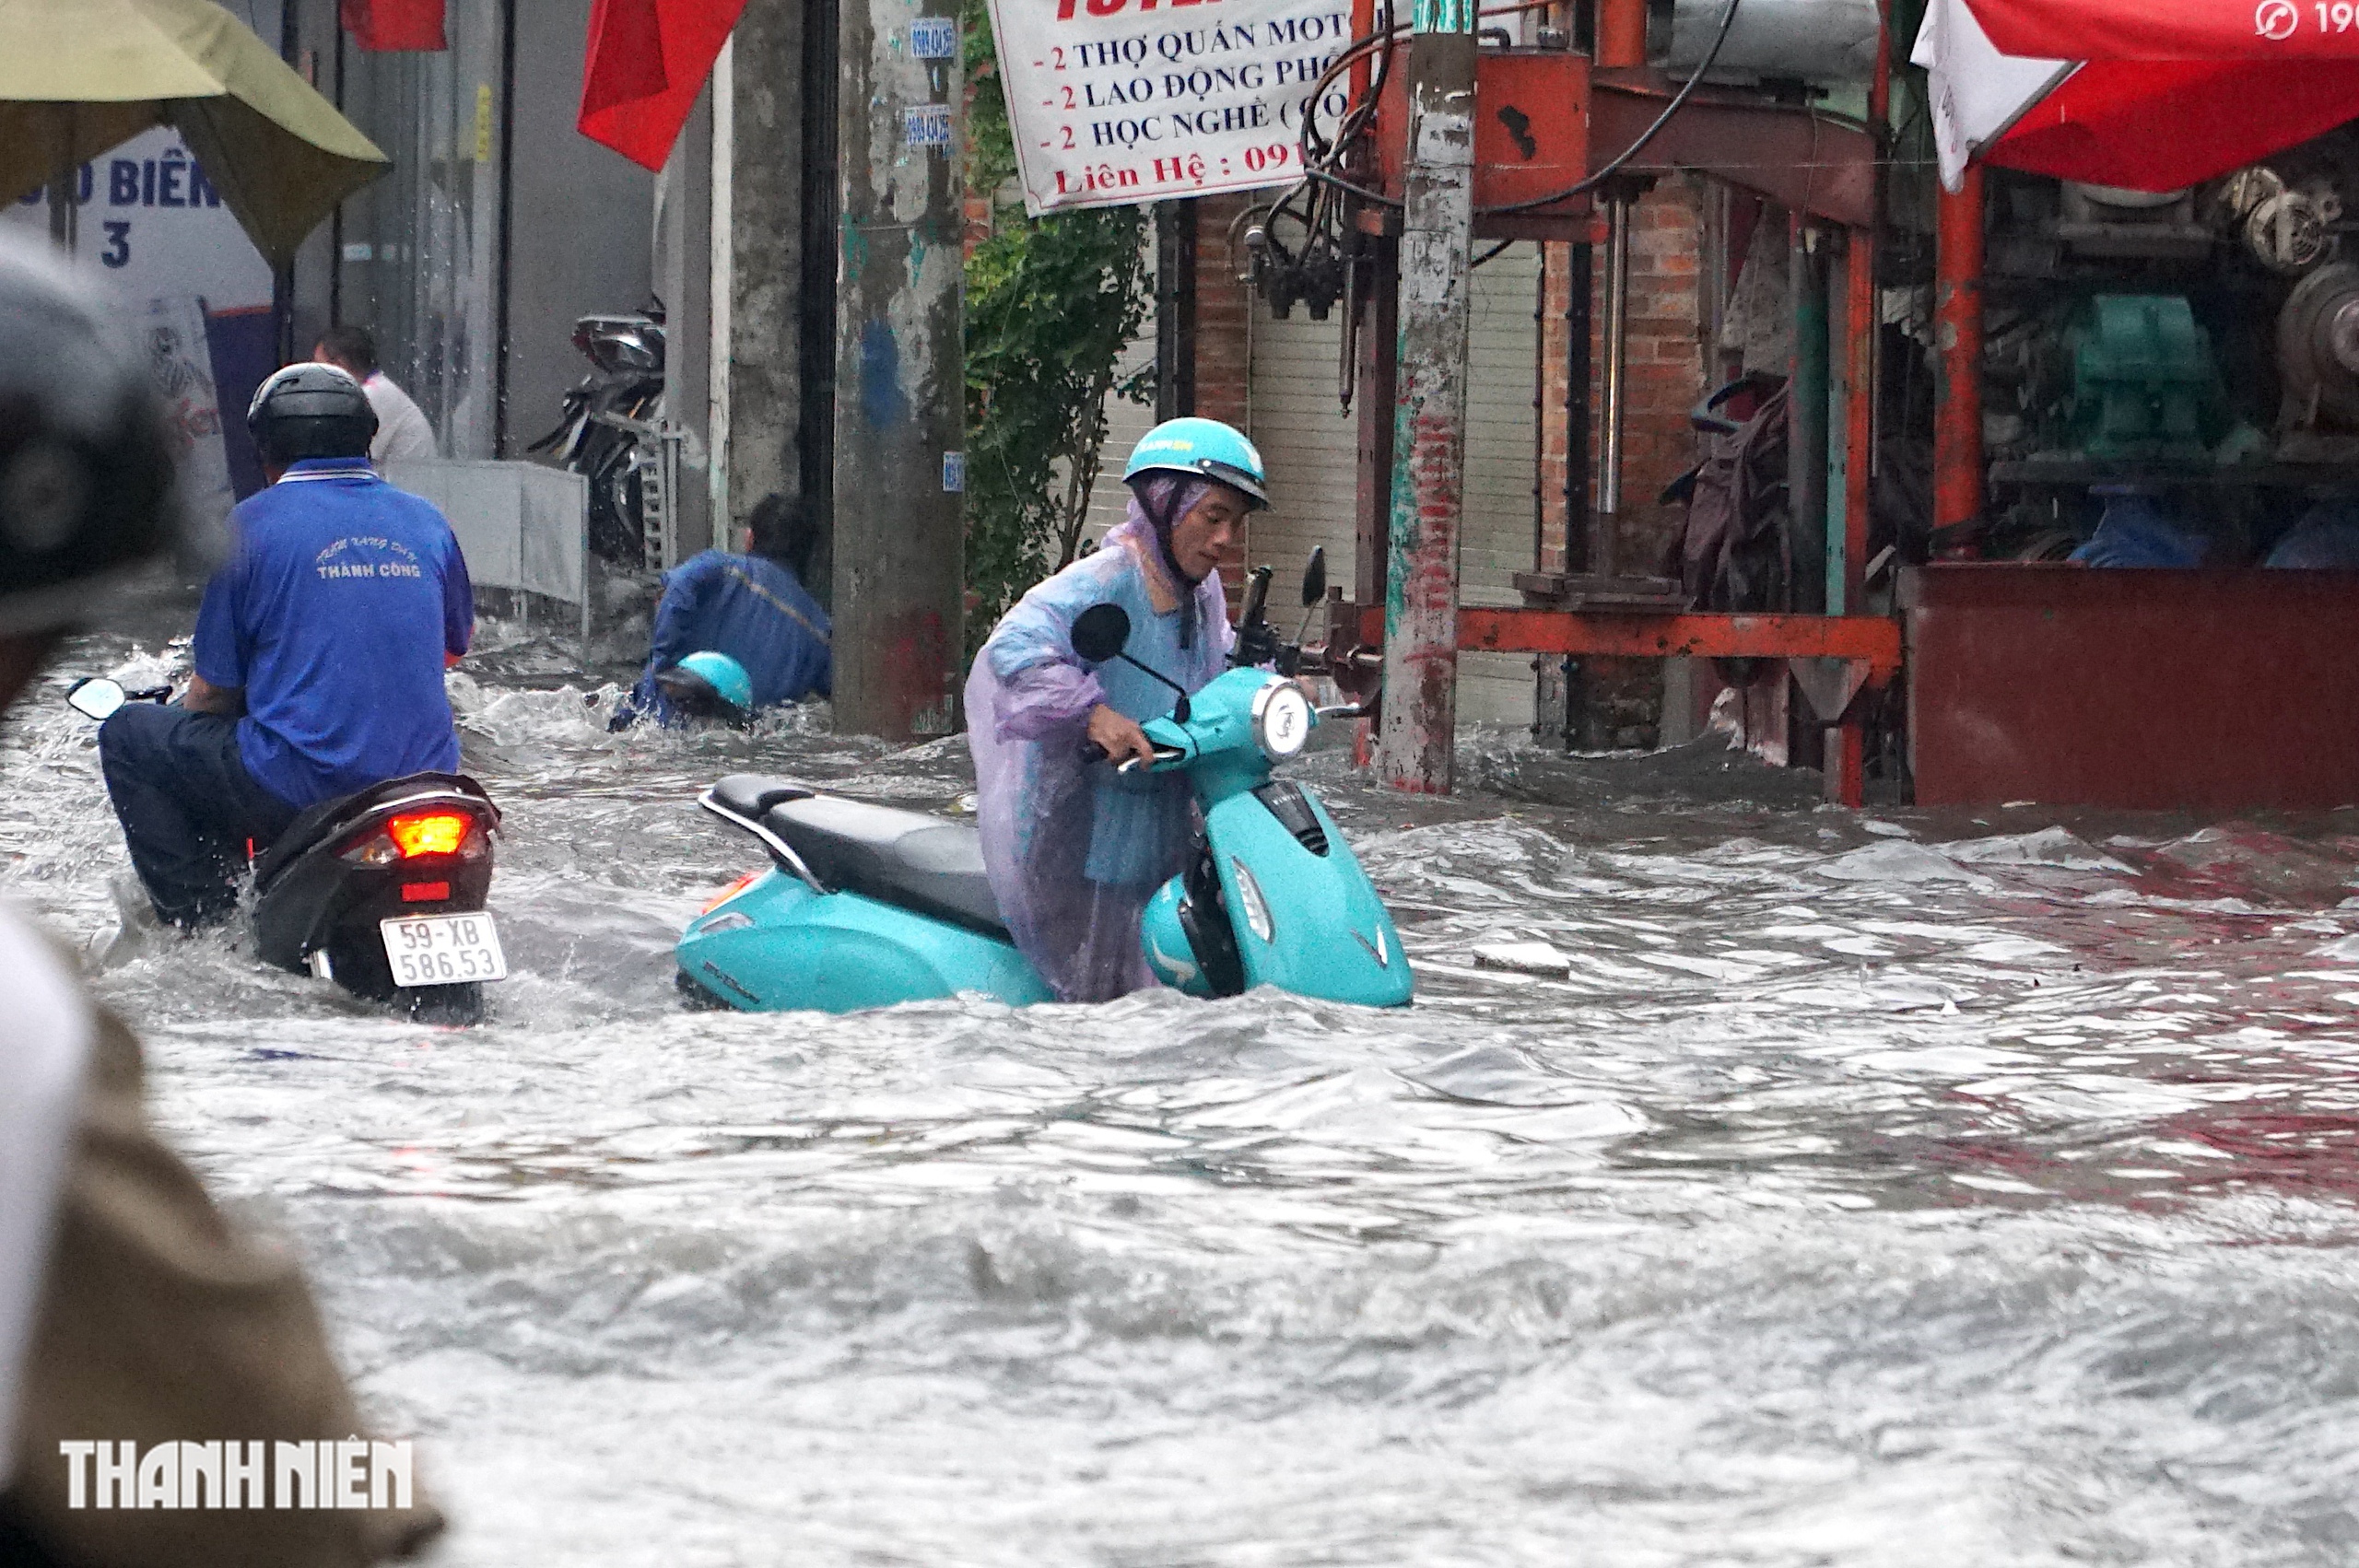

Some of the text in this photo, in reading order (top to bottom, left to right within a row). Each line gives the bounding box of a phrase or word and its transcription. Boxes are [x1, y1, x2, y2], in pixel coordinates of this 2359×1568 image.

[2315, 2, 2359, 33] 19
[1073, 33, 1147, 69] THỢ
[1084, 77, 1153, 108] LAO
[1162, 63, 1263, 101] ĐỘNG
[1090, 116, 1163, 150] HỌC
[1054, 163, 1141, 194] Liên
[1152, 152, 1206, 186] Hệ
[101, 221, 130, 269] 3
[399, 949, 496, 981] 586.53
